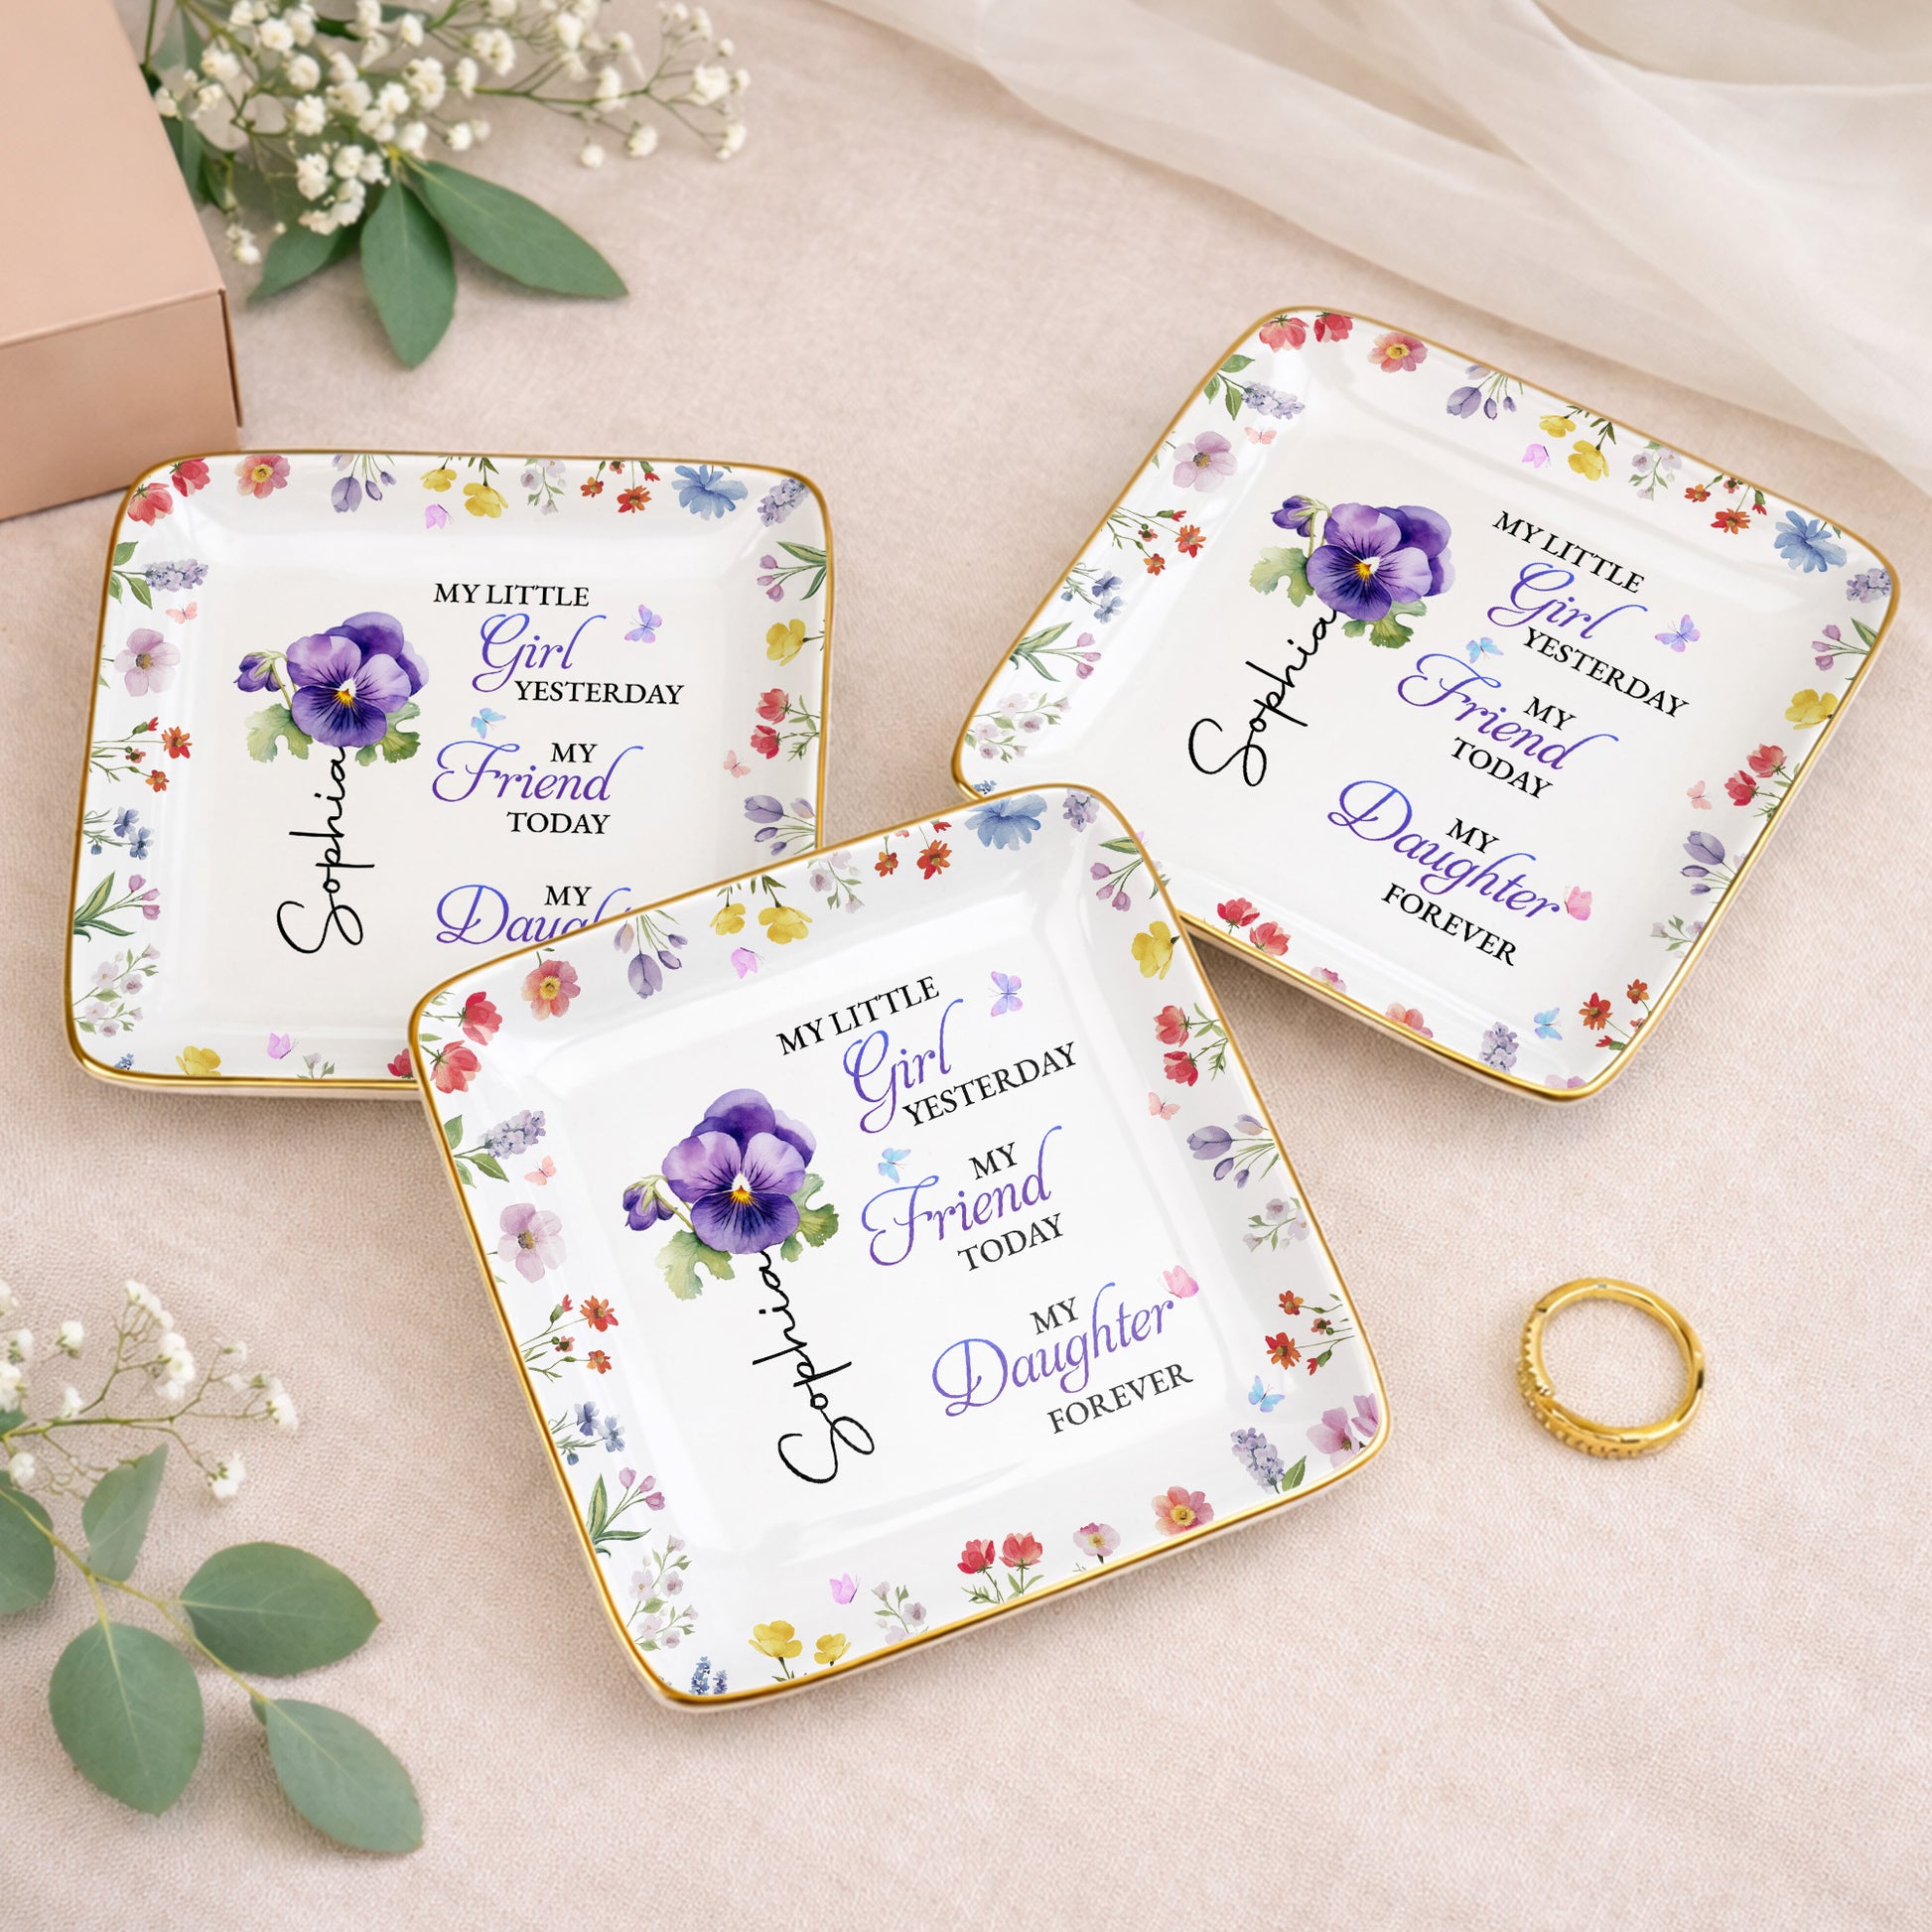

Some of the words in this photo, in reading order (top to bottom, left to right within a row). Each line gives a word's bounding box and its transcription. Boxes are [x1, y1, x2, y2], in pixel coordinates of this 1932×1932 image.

[1492, 510, 1546, 548] MY
[1541, 532, 1645, 594] LITTLE
[433, 584, 481, 604] MY
[486, 585, 590, 607] LITTLE
[1487, 562, 1648, 639] Girl
[472, 614, 607, 692] Girl
[1523, 627, 1689, 718] YESTERDAY
[514, 680, 685, 705] YESTERDAY
[1188, 610, 1337, 787] Sophia
[1397, 653, 1619, 770] Friend
[1523, 696, 1577, 732] MY
[432, 741, 644, 802] Friend
[551, 743, 598, 763] MY
[1451, 737, 1553, 799] TODAY
[276, 747, 375, 953] Sophia
[506, 811, 611, 834] TODAY
[1327, 780, 1560, 918] Daughter
[1446, 818, 1500, 853] MY
[544, 886, 592, 906] MY
[1381, 884, 1517, 966] FOREVER
[775, 1019, 828, 1055] MY
[828, 976, 939, 1035] LITTLE
[842, 999, 964, 1134] Girl
[902, 1041, 1078, 1127] YESTERDAY
[861, 1125, 1062, 1266] Friend
[969, 1142, 1019, 1179] MY
[957, 1213, 1064, 1271] TODAY
[932, 1283, 1174, 1417] Daughter
[1030, 1297, 1079, 1334] MY
[752, 1251, 875, 1484] Sophia
[1047, 1363, 1193, 1434] FOREVER
